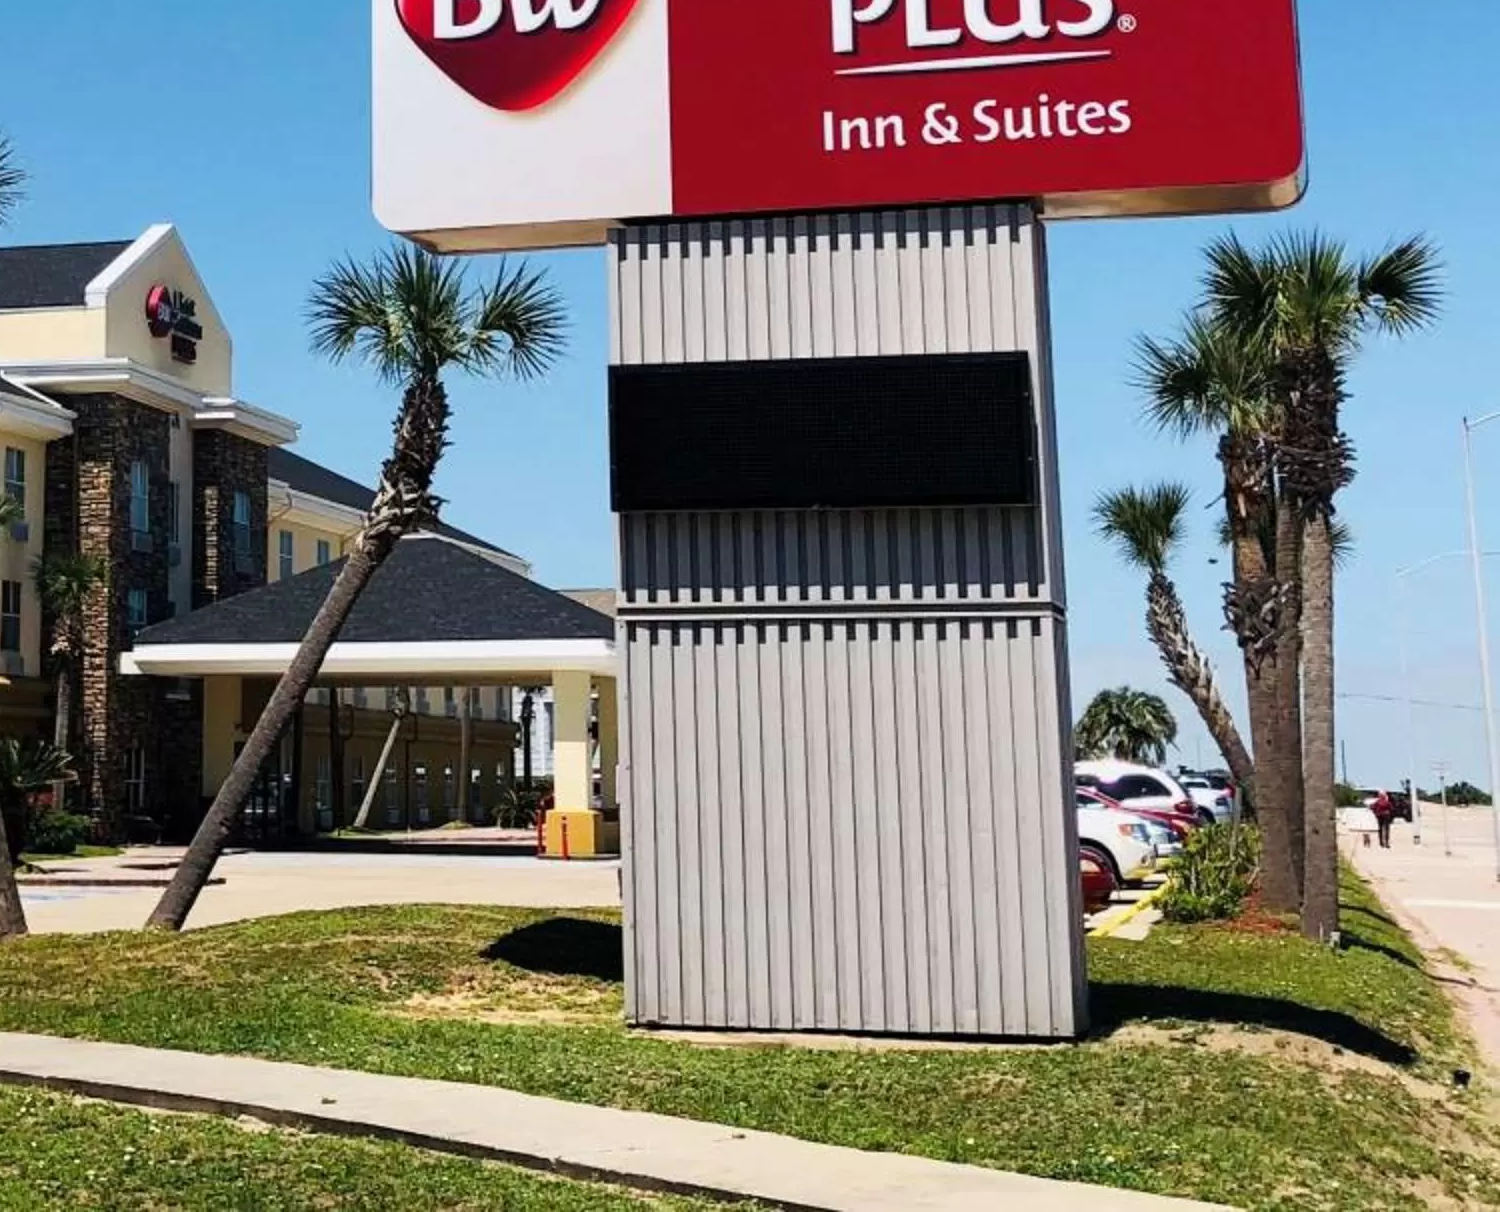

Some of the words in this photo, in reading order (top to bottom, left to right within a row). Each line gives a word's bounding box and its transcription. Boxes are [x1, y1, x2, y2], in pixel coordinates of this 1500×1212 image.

[823, 110, 907, 151] Inn
[921, 102, 962, 145] &
[973, 99, 1131, 142] Suites
